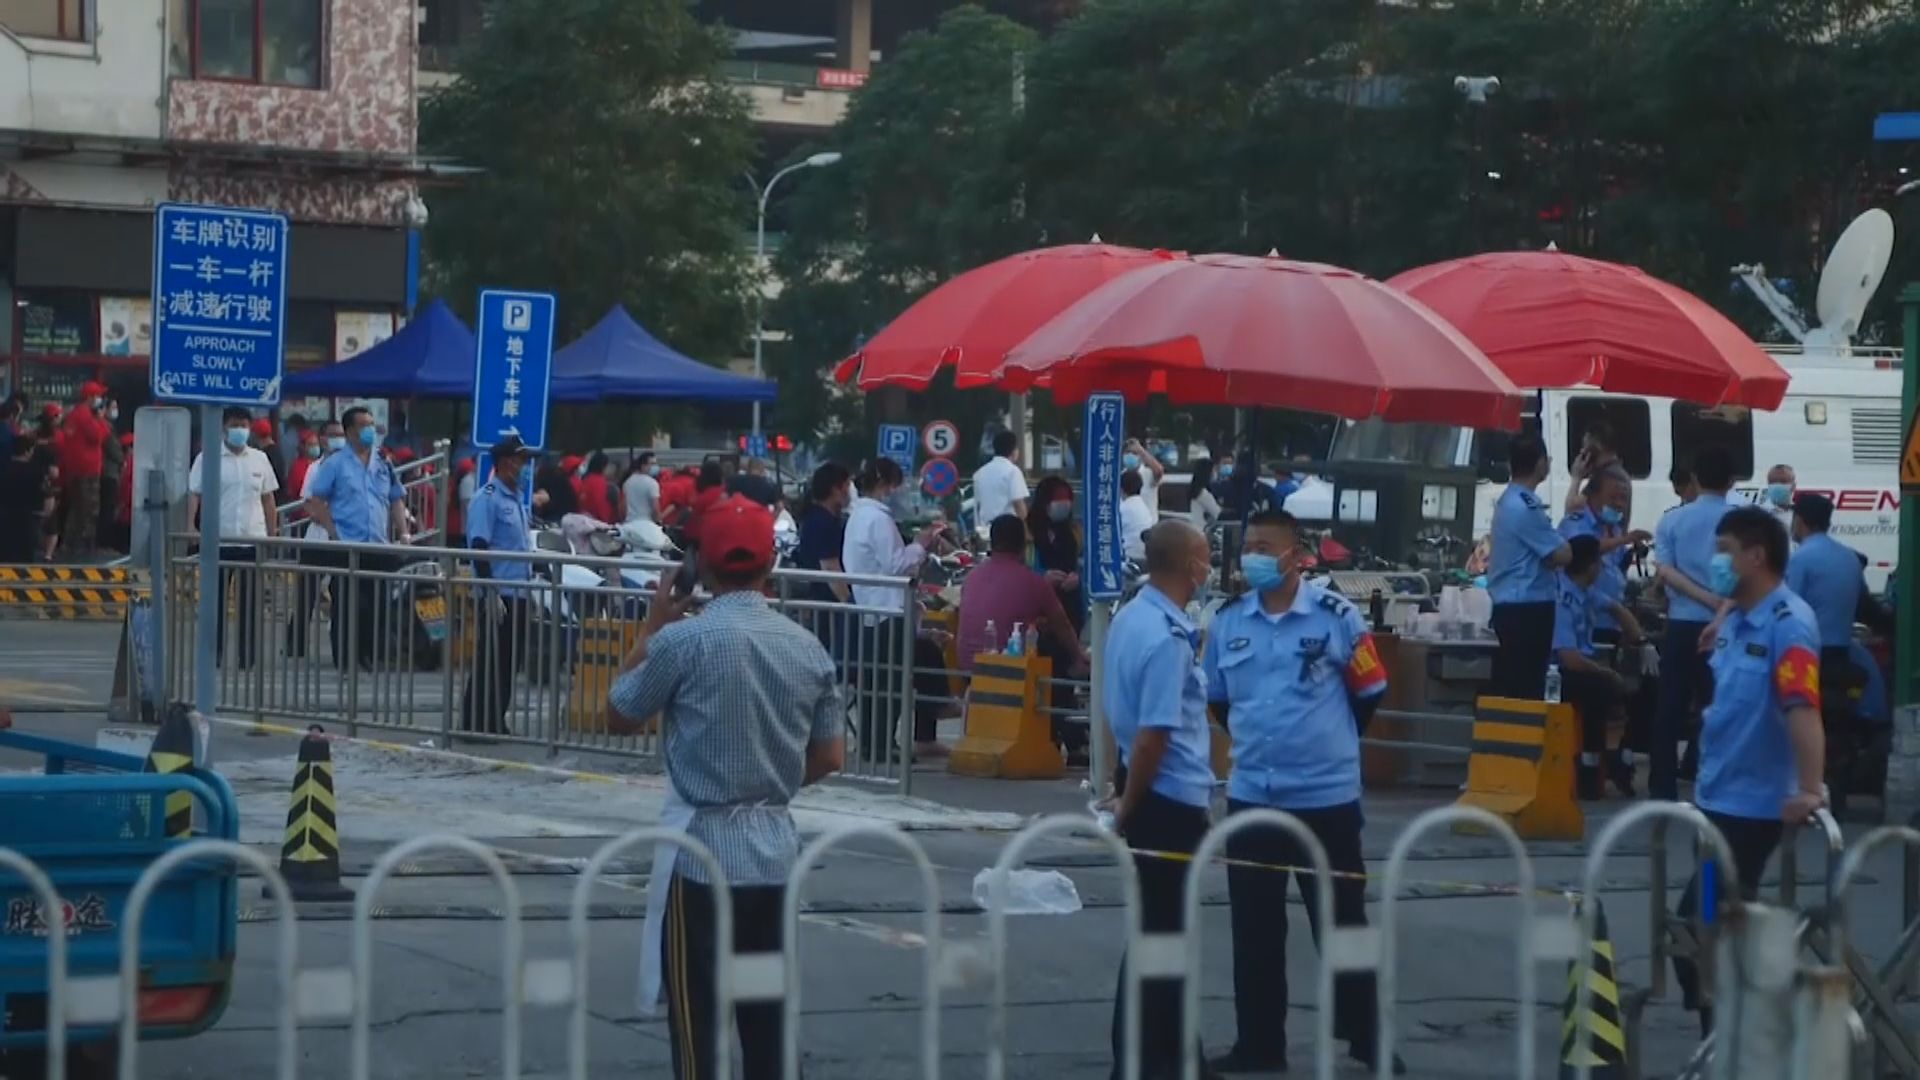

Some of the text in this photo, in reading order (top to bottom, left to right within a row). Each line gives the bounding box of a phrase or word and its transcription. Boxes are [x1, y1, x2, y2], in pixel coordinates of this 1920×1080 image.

[171, 218, 276, 252] 车牌识别
[170, 256, 274, 287] 一车一杆
[169, 289, 273, 322] 减速行驶
[511, 305, 524, 325] P
[184, 336, 255, 353] APPROACH
[192, 355, 246, 371] SLOWLY
[162, 371, 197, 387] GATE
[203, 374, 233, 389] WILL
[502, 336, 524, 419] 地下车库
[889, 432, 905, 450] P
[934, 430, 948, 450] 5
[1098, 401, 1116, 564] 行人非机动车通道
